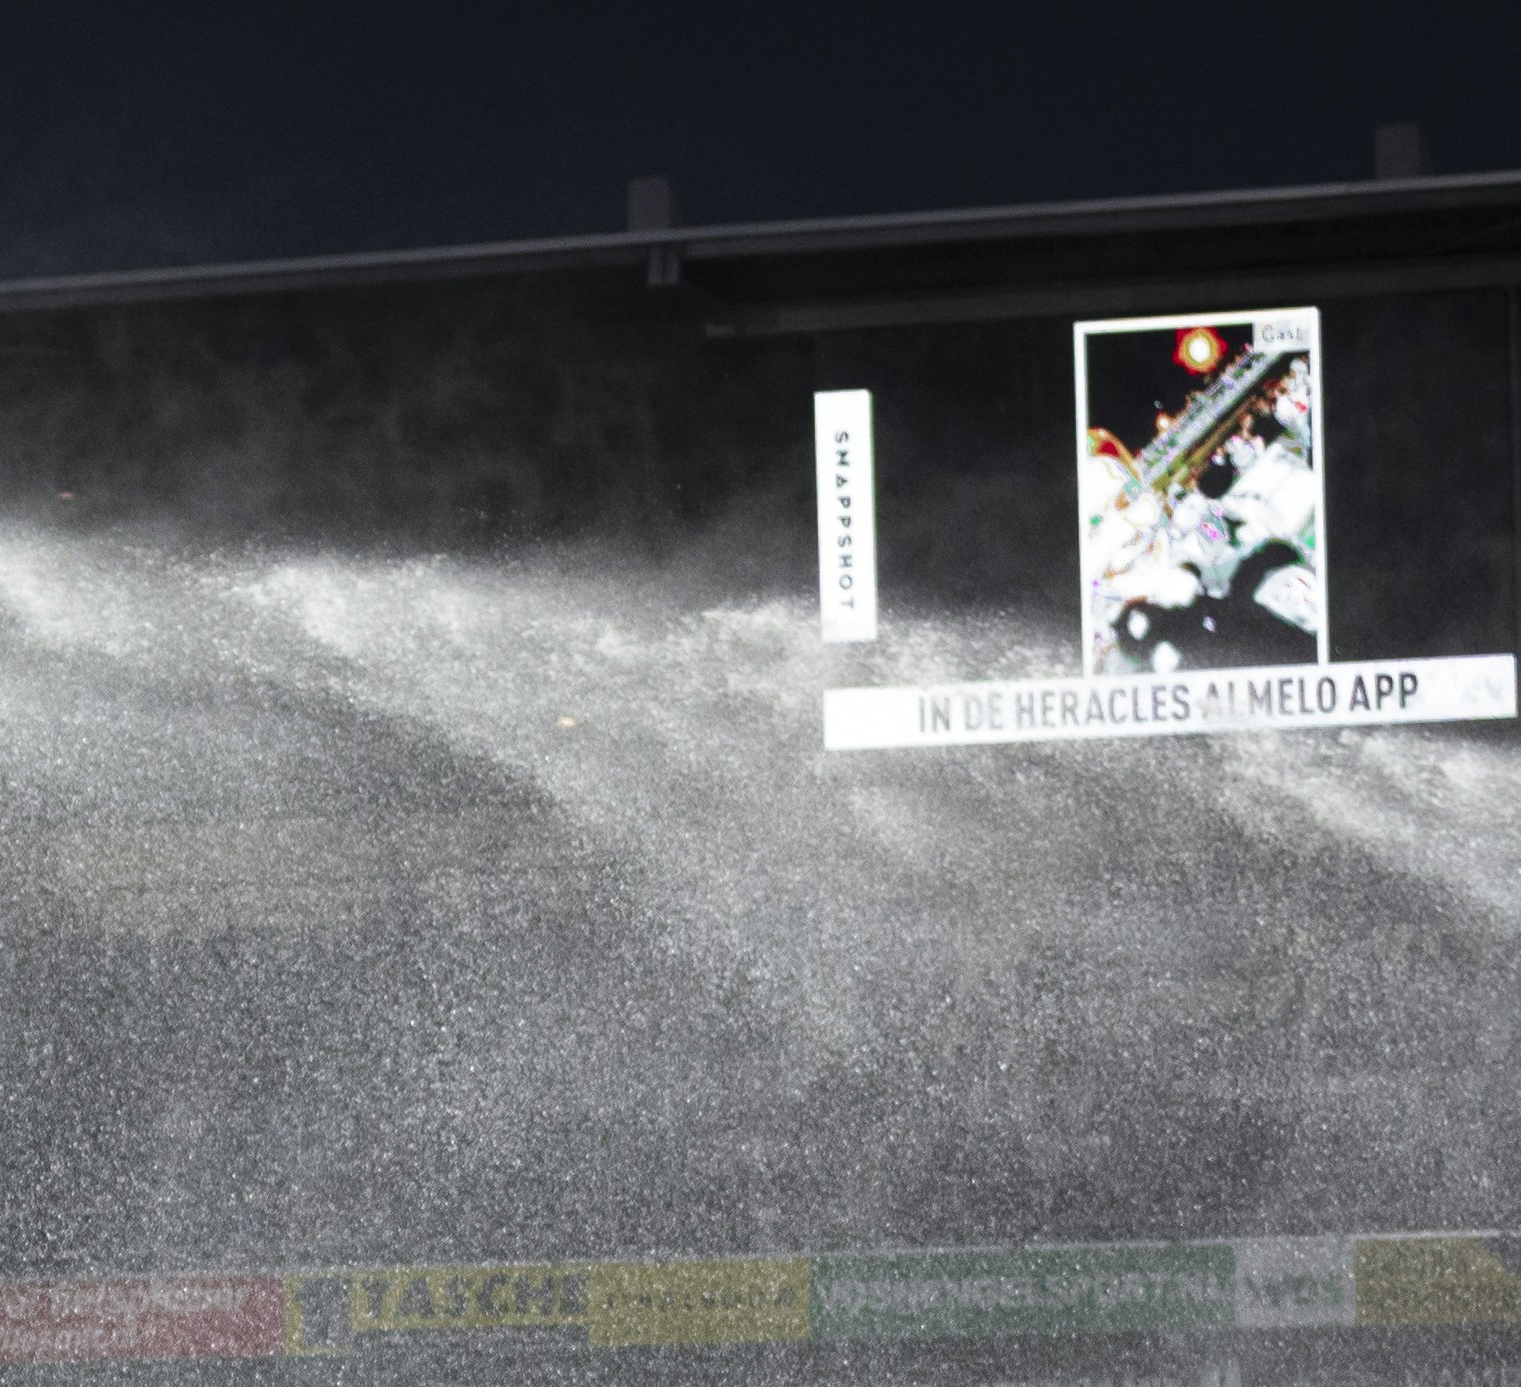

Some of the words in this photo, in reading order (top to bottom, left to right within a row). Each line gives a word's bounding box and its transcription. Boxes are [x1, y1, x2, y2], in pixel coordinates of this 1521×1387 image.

[834, 430, 856, 610] SNAPPSHOT
[917, 693, 952, 733] IN
[963, 690, 1004, 732] DE
[1014, 684, 1190, 729] HERACLES
[1349, 672, 1420, 713] APP
